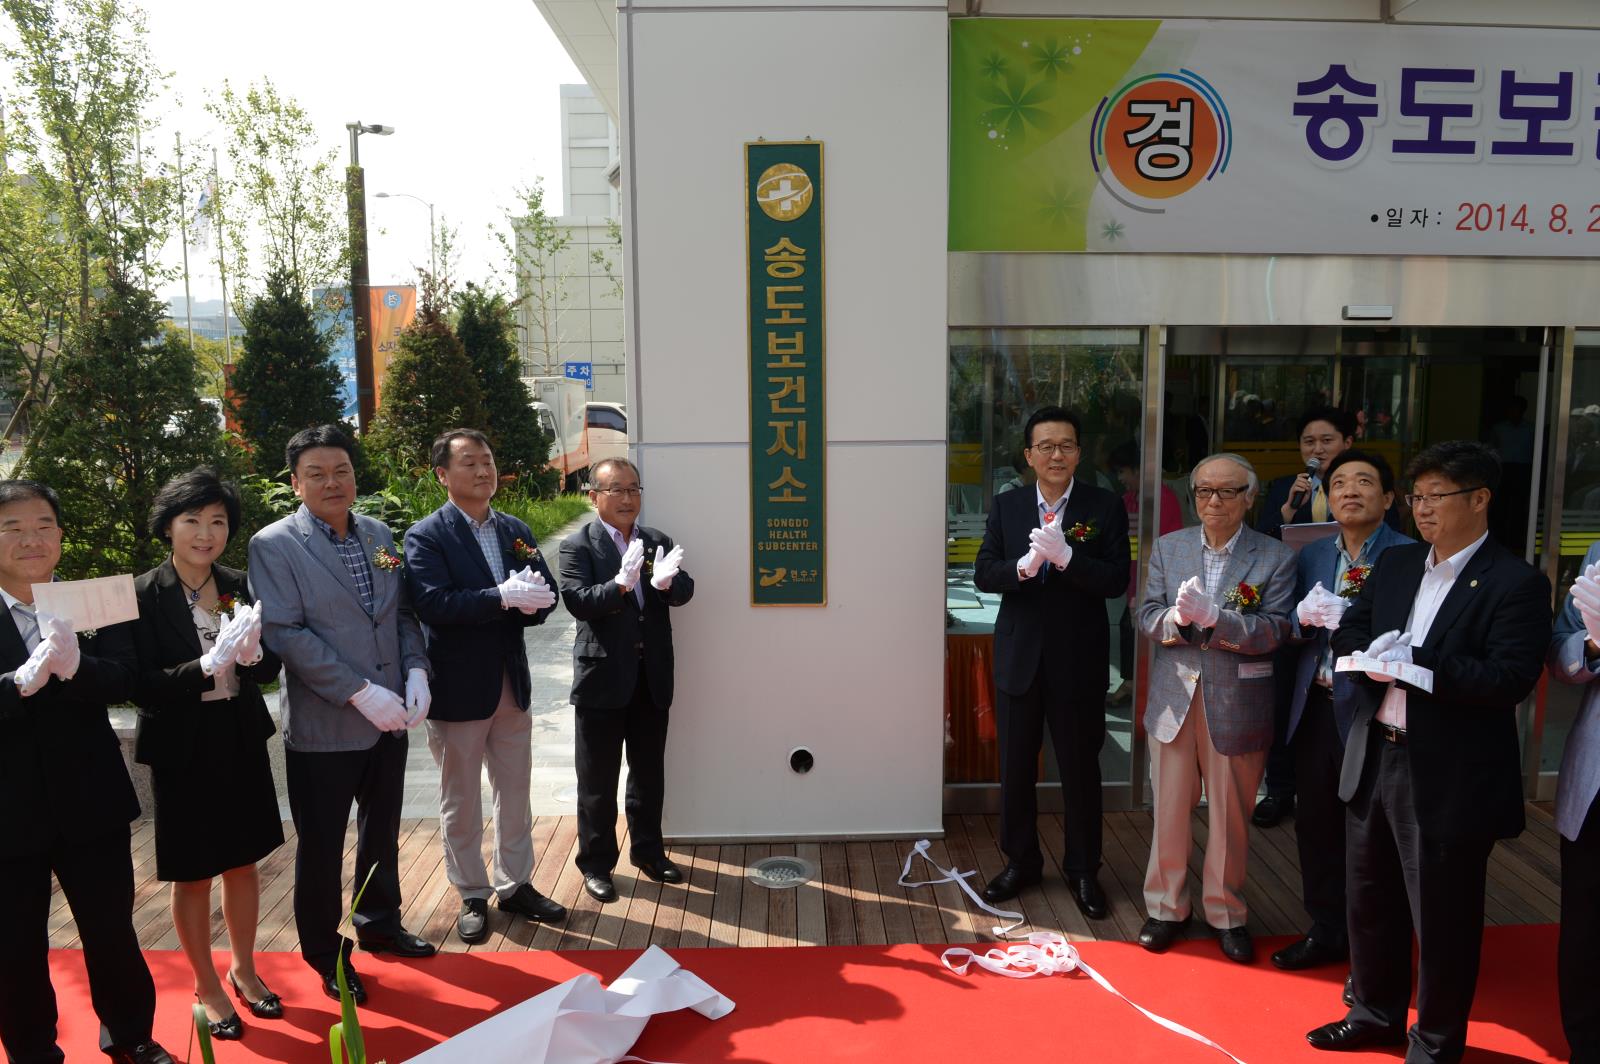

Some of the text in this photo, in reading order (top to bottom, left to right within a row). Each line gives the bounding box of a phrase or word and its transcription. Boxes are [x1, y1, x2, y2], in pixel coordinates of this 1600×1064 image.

[1294, 64, 1600, 161] 송도보
[1124, 97, 1194, 181] 경
[1455, 202, 1535, 235] 2014.
[1548, 203, 1573, 235] 8.
[566, 365, 590, 377] 주차
[764, 236, 807, 502] 송도보건지소
[767, 518, 809, 528] SONGDO
[769, 530, 808, 539] HEALTH
[758, 542, 818, 551] SUBCENTER
